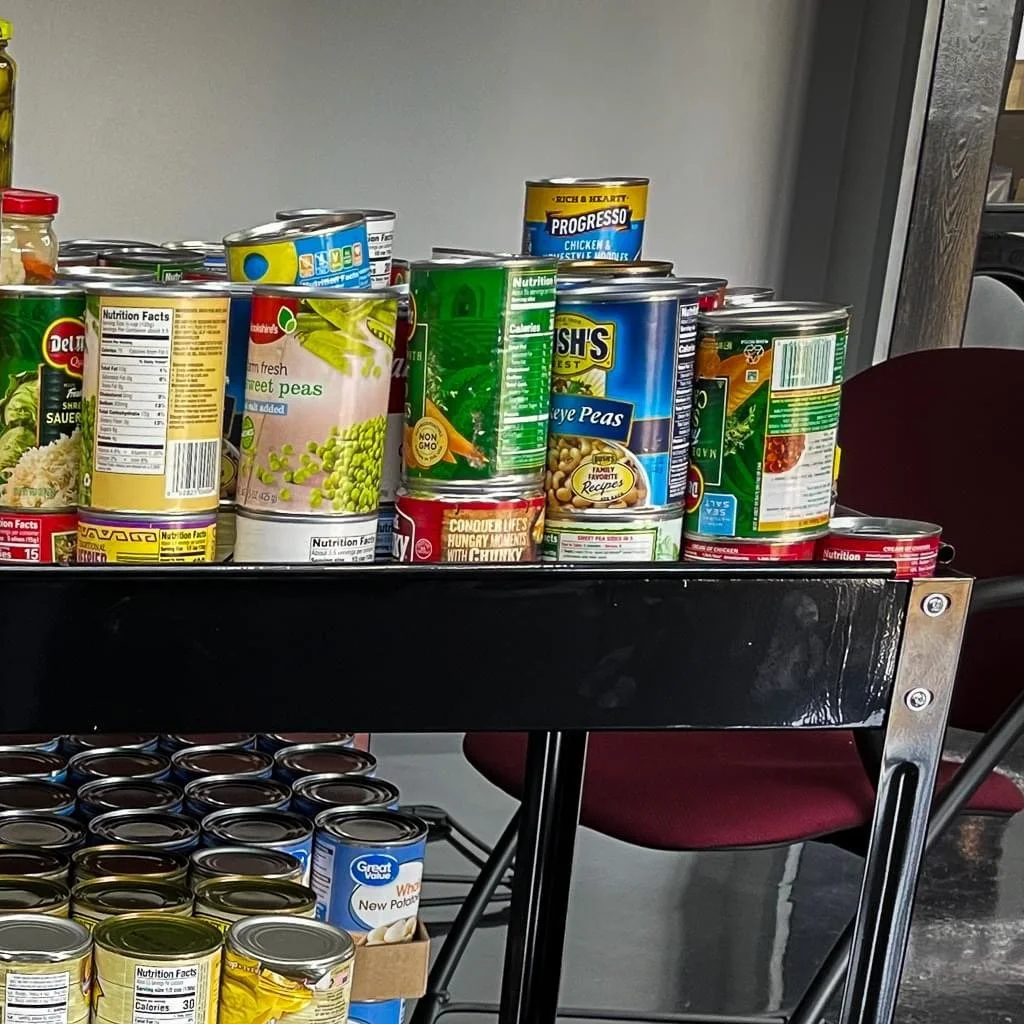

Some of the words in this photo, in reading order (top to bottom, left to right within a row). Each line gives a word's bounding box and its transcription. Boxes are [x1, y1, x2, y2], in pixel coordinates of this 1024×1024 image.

[551, 208, 627, 235] PROGRESSO
[564, 240, 602, 251] CHICKEN
[604, 240, 611, 250] &
[513, 275, 553, 288] Nutrition
[102, 309, 138, 322] Nutrition
[140, 310, 170, 322] Facts
[49, 334, 70, 352] Del
[261, 360, 288, 376] fresh
[278, 381, 323, 399] peas
[259, 403, 285, 415] added
[578, 406, 624, 427] Peas
[418, 432, 437, 441] NON
[418, 442, 437, 450] GMO
[581, 480, 623, 496] Recipes
[703, 508, 726, 516] SEA
[14, 520, 39, 530] Facts
[449, 518, 502, 533] CONQUER
[504, 518, 527, 532] LIFE'S
[312, 537, 358, 548] Nutrition
[448, 534, 489, 548] HUNGRY
[24, 548, 39, 560] 15
[448, 549, 467, 562] WITH
[469, 547, 523, 562] CHUNKY
[824, 549, 861, 561] Nutrition
[357, 860, 392, 872] Great
[364, 870, 391, 880] Value
[396, 882, 420, 897] Who
[358, 900, 387, 911] New
[137, 967, 174, 979] Nutrition
[176, 969, 197, 977] Facts
[135, 1001, 170, 1012] Calories
[182, 998, 195, 1010] 30
